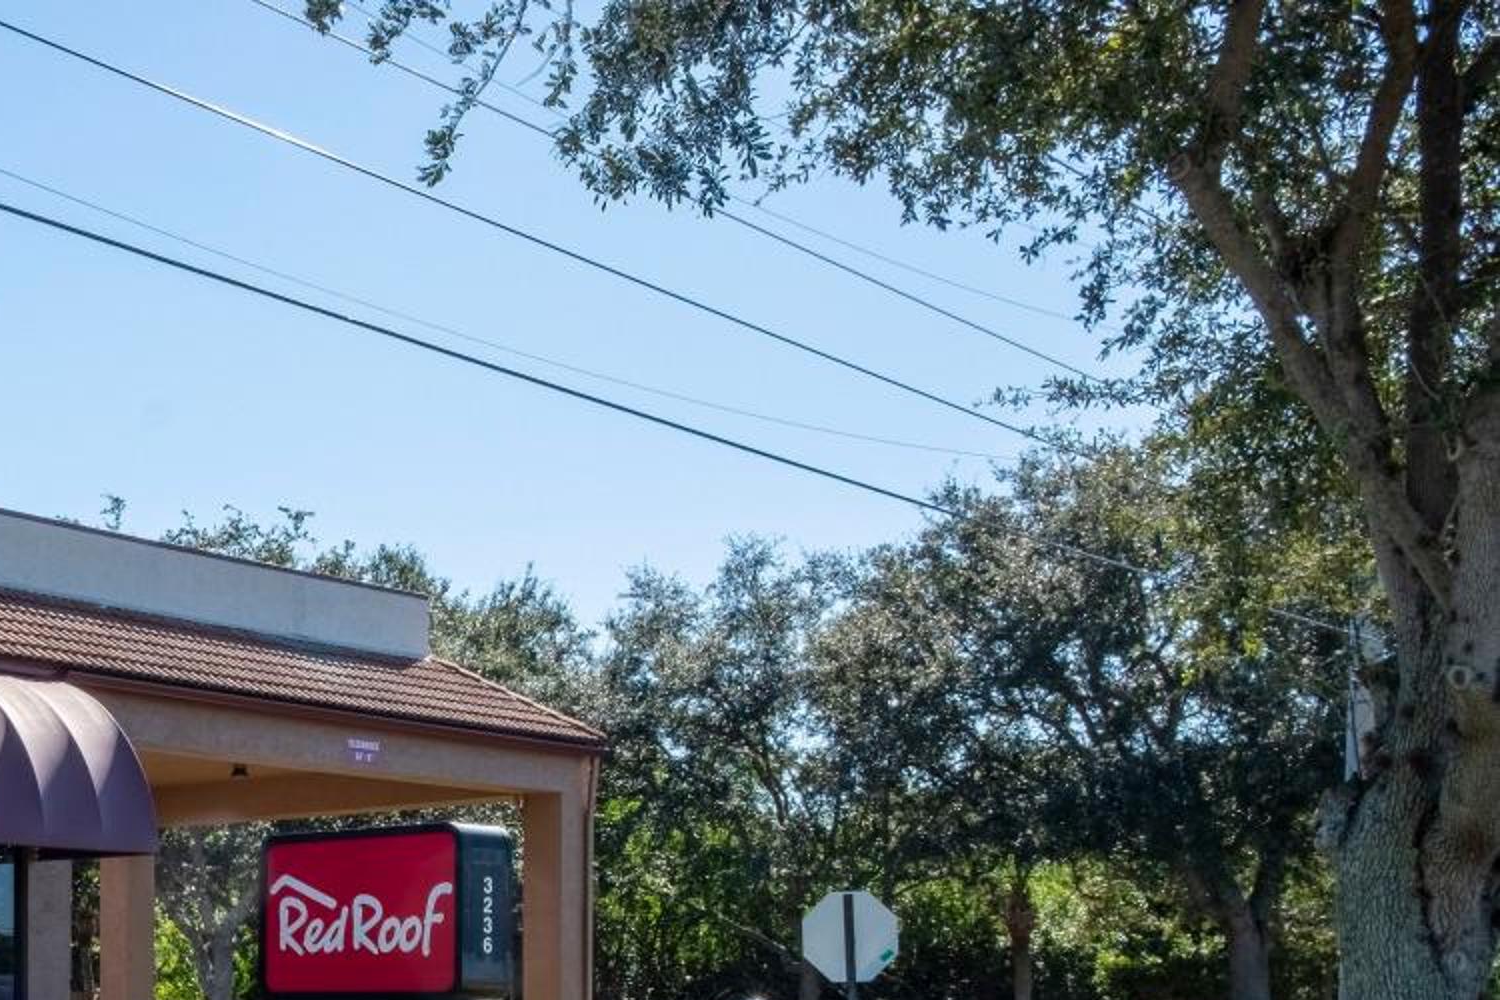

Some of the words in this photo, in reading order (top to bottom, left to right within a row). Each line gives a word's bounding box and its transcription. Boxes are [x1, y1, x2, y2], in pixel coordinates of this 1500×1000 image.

[279, 896, 348, 956] Red
[353, 881, 453, 957] Roof
[482, 876, 493, 953] 3236
